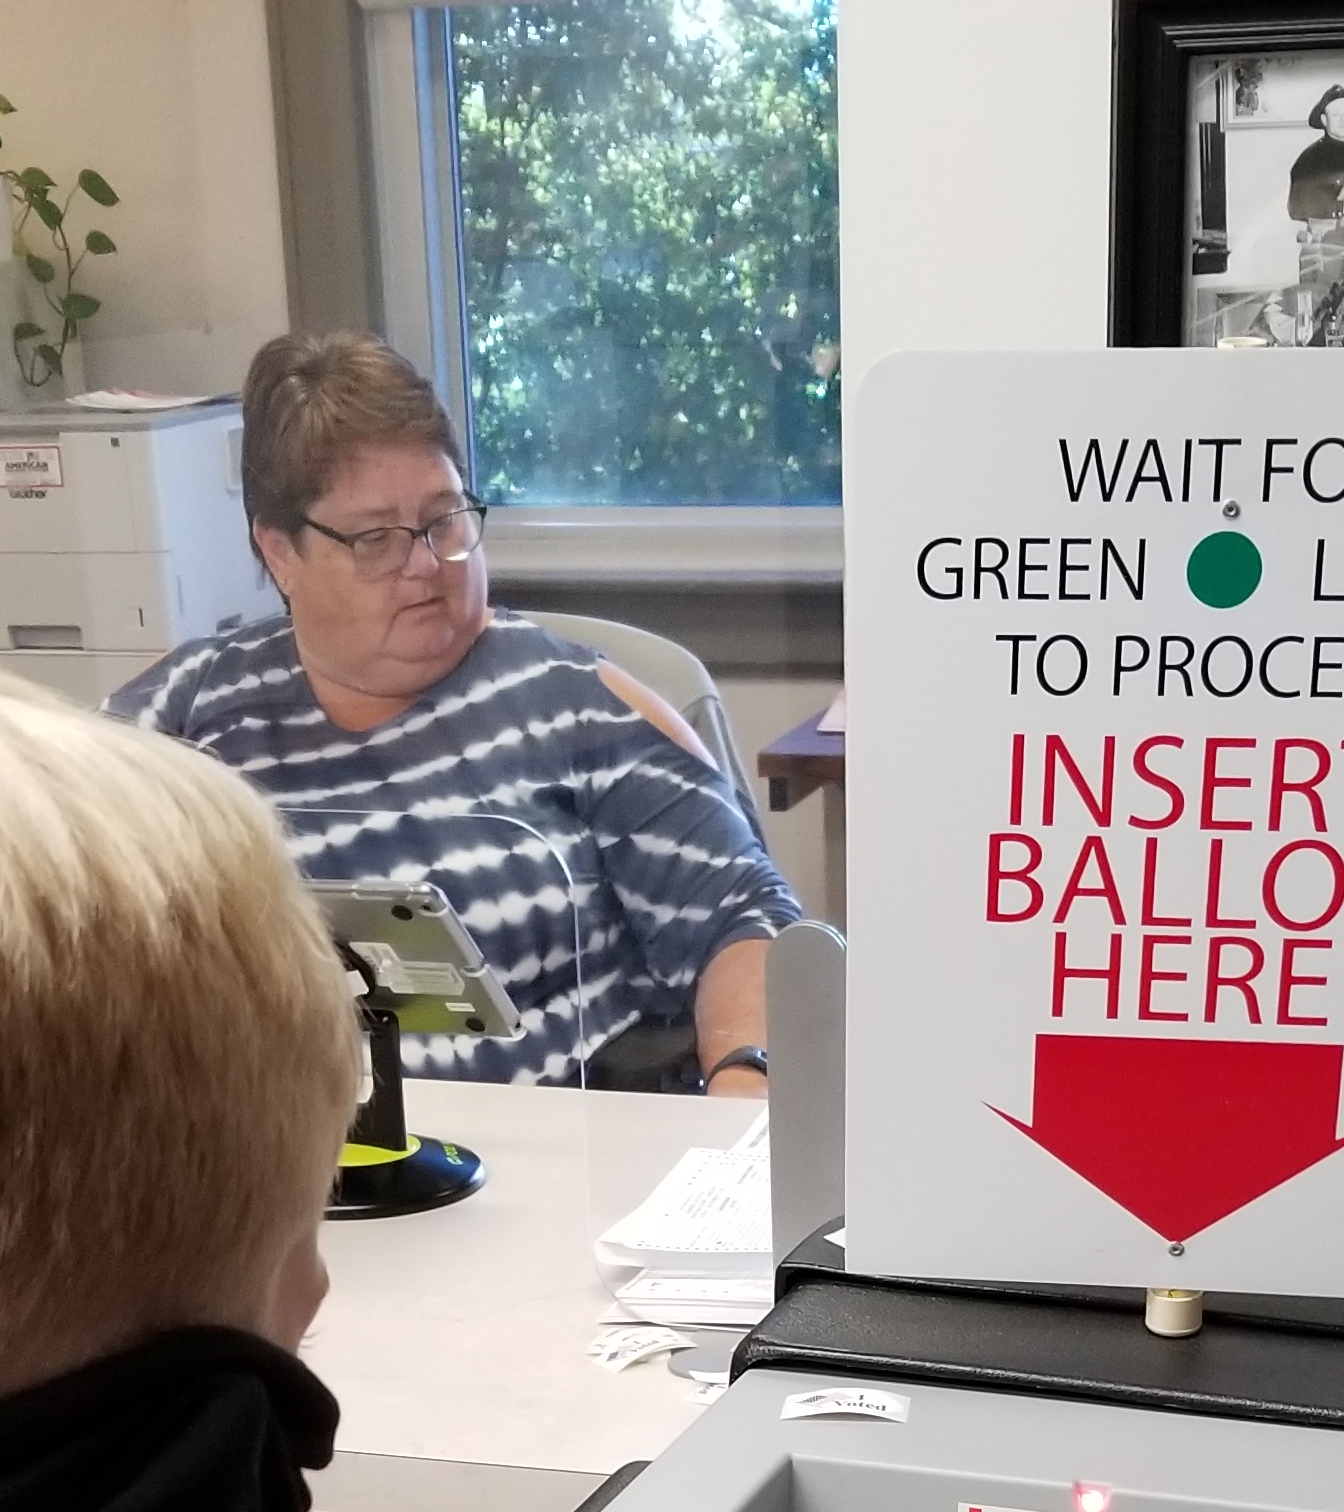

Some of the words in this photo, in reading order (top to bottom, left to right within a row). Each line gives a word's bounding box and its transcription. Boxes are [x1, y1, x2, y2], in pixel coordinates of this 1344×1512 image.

[1058, 437, 1242, 504] WAIT
[915, 536, 1147, 602] GREEN
[995, 634, 1089, 698] TO
[1050, 931, 1334, 1028] HERE
[834, 1400, 887, 1412] Voted
